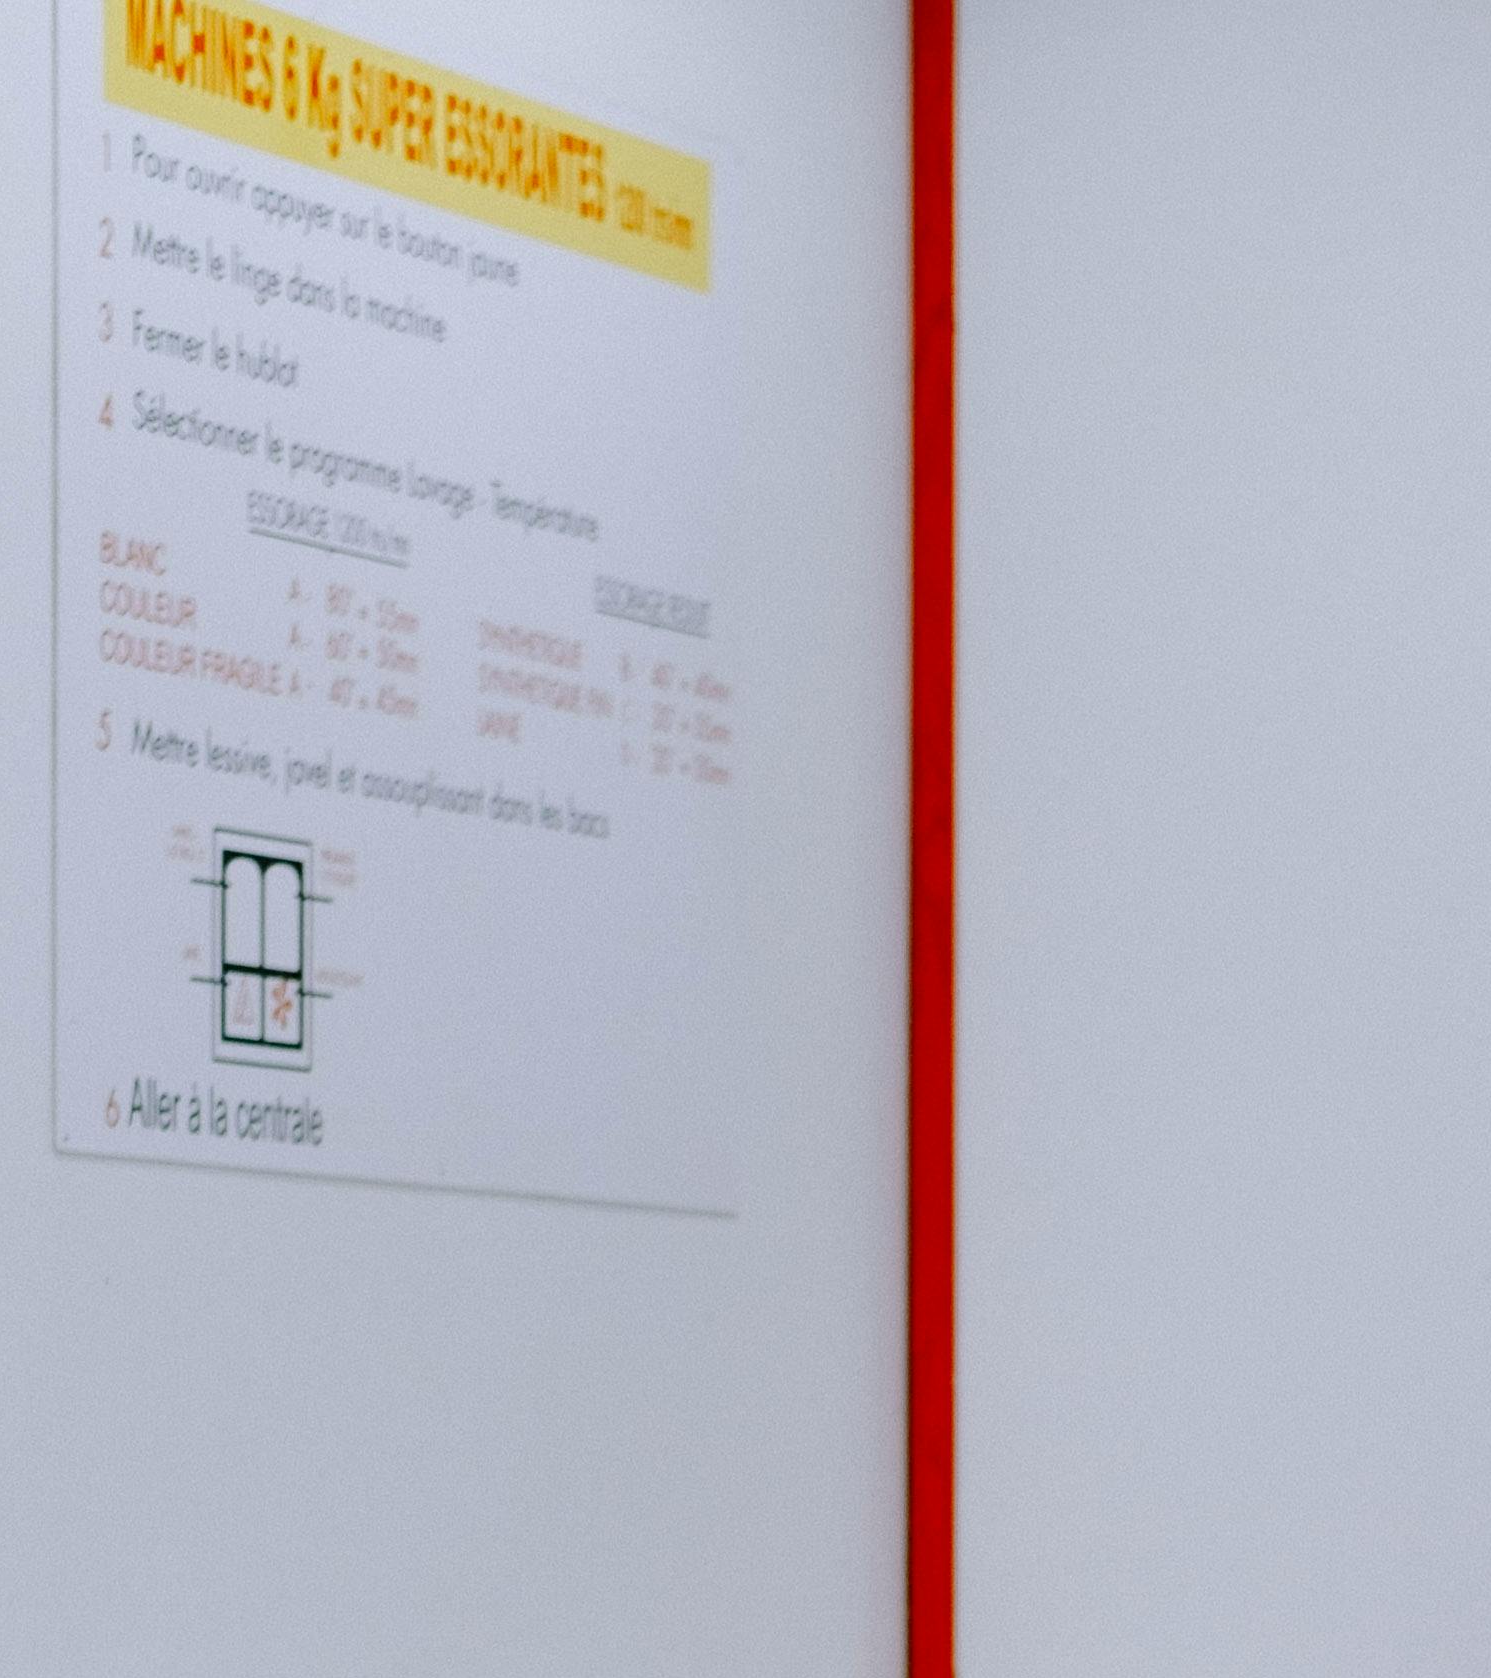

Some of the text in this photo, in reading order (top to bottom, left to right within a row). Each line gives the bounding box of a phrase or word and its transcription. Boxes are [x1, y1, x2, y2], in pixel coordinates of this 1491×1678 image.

[126, 0, 275, 113] MACHINES
[283, 34, 300, 121] 6
[307, 43, 342, 158] Kg
[349, 55, 436, 170] SUPER
[445, 91, 606, 223] ESSORANTES
[100, 217, 114, 259] 2
[98, 302, 113, 342] 3
[97, 395, 115, 431] 4
[105, 1088, 120, 1128] 6
